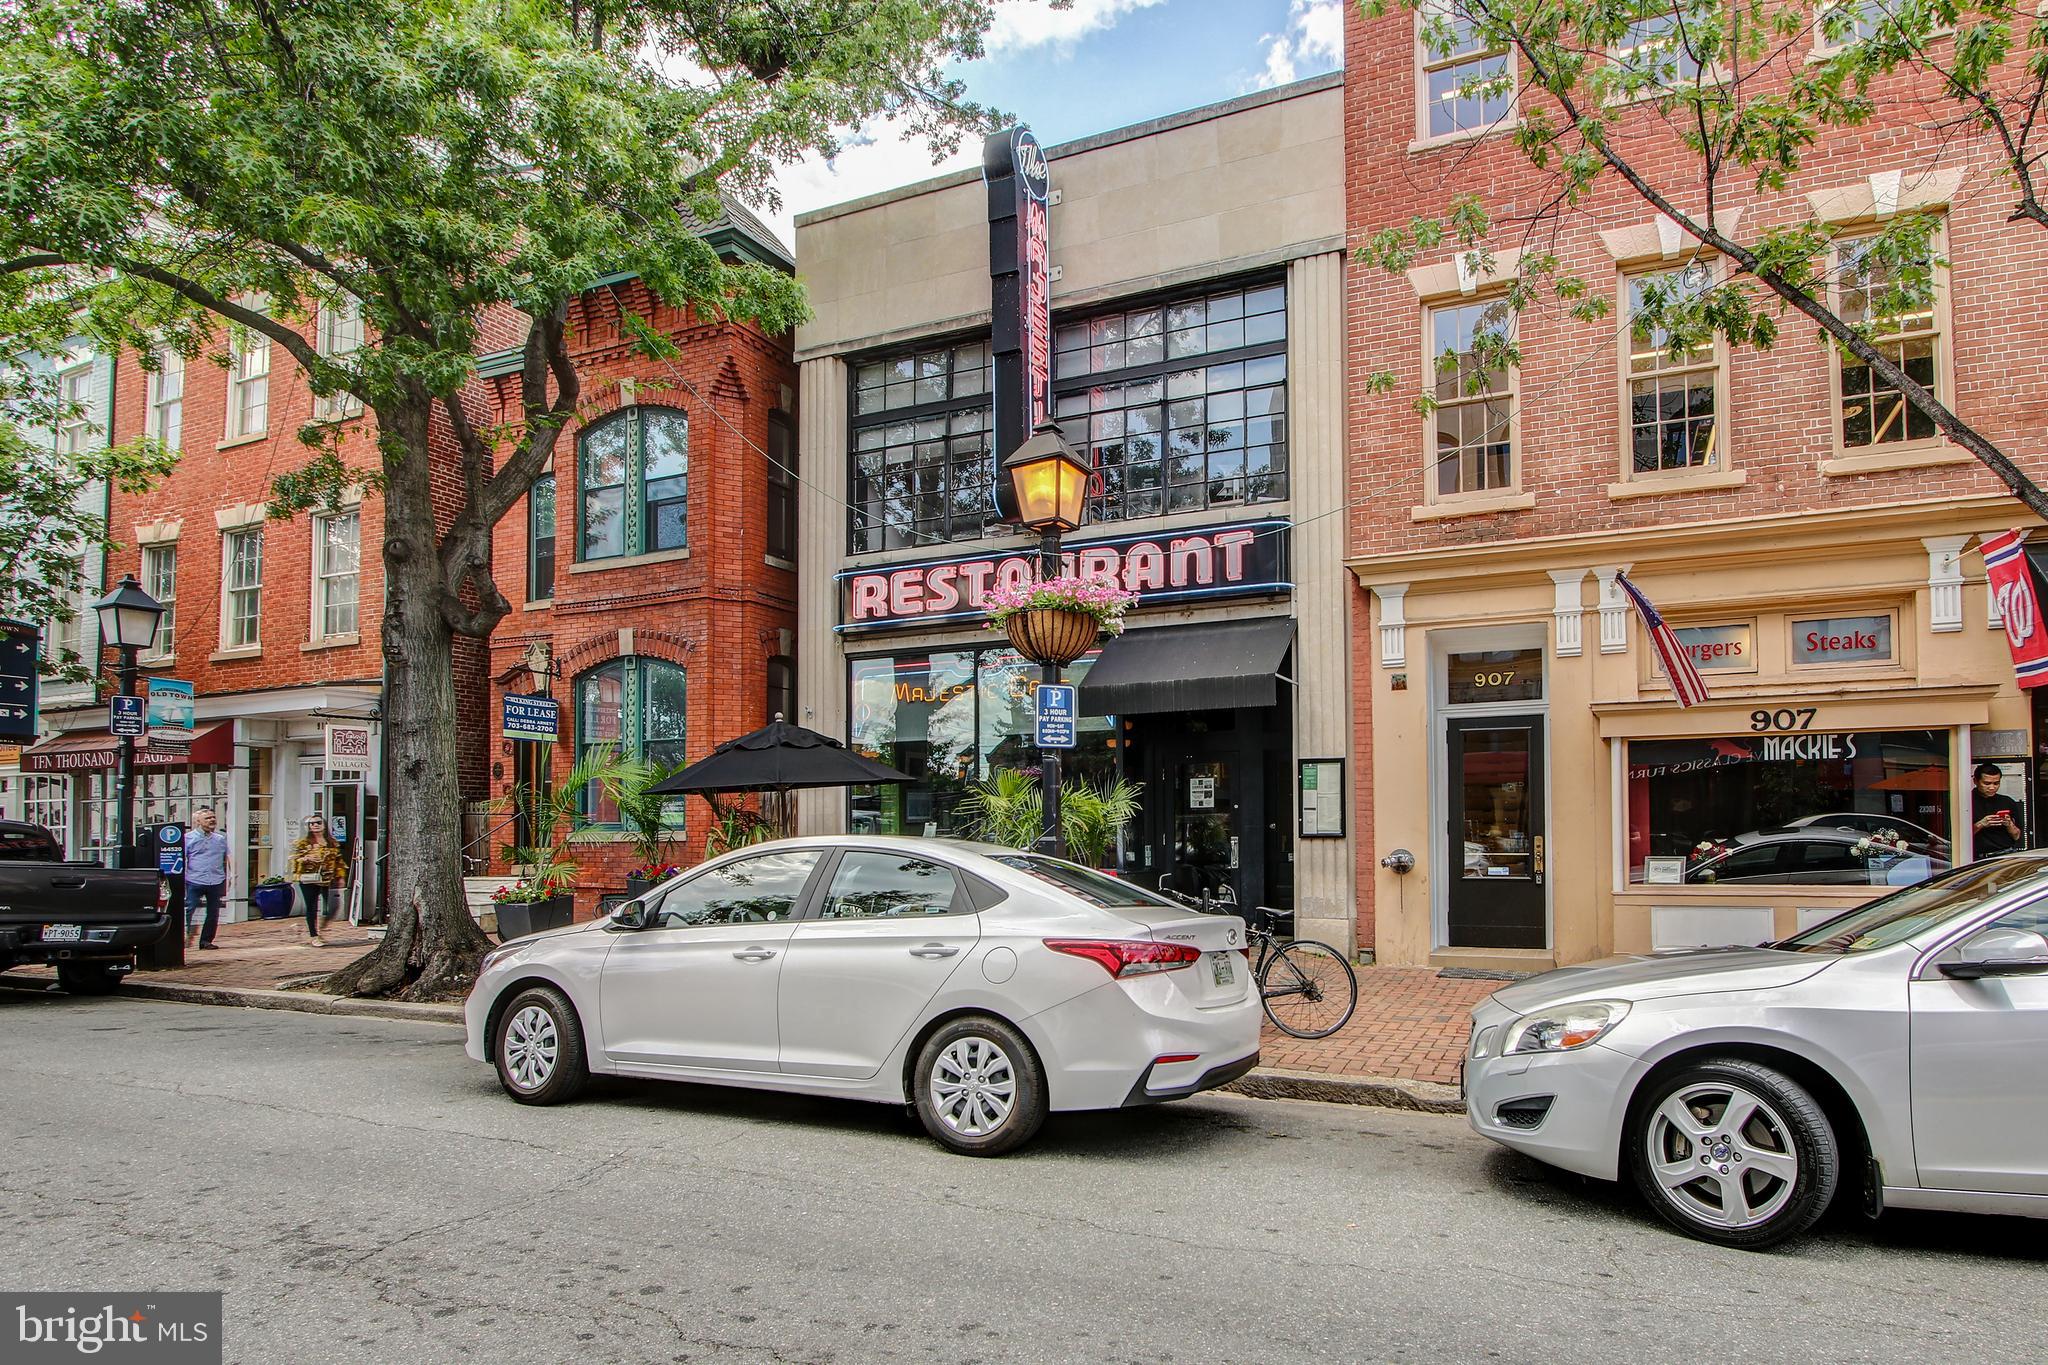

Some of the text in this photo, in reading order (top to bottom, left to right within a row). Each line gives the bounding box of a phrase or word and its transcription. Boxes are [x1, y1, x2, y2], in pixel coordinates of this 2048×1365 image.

[1017, 144, 1047, 180] The
[1030, 202, 1048, 426] MAJESTI
[1806, 630, 1878, 652] Steaks
[1683, 641, 1743, 661] urgers
[1474, 671, 1516, 687] 907
[169, 692, 193, 700] TOWN
[506, 705, 557, 719] FOR LEASE
[1044, 708, 1049, 716] 3
[1051, 715, 1072, 723] PARKING
[1750, 708, 1817, 732] 907
[32, 755, 52, 769] TEN
[56, 751, 114, 768] THOUSAND
